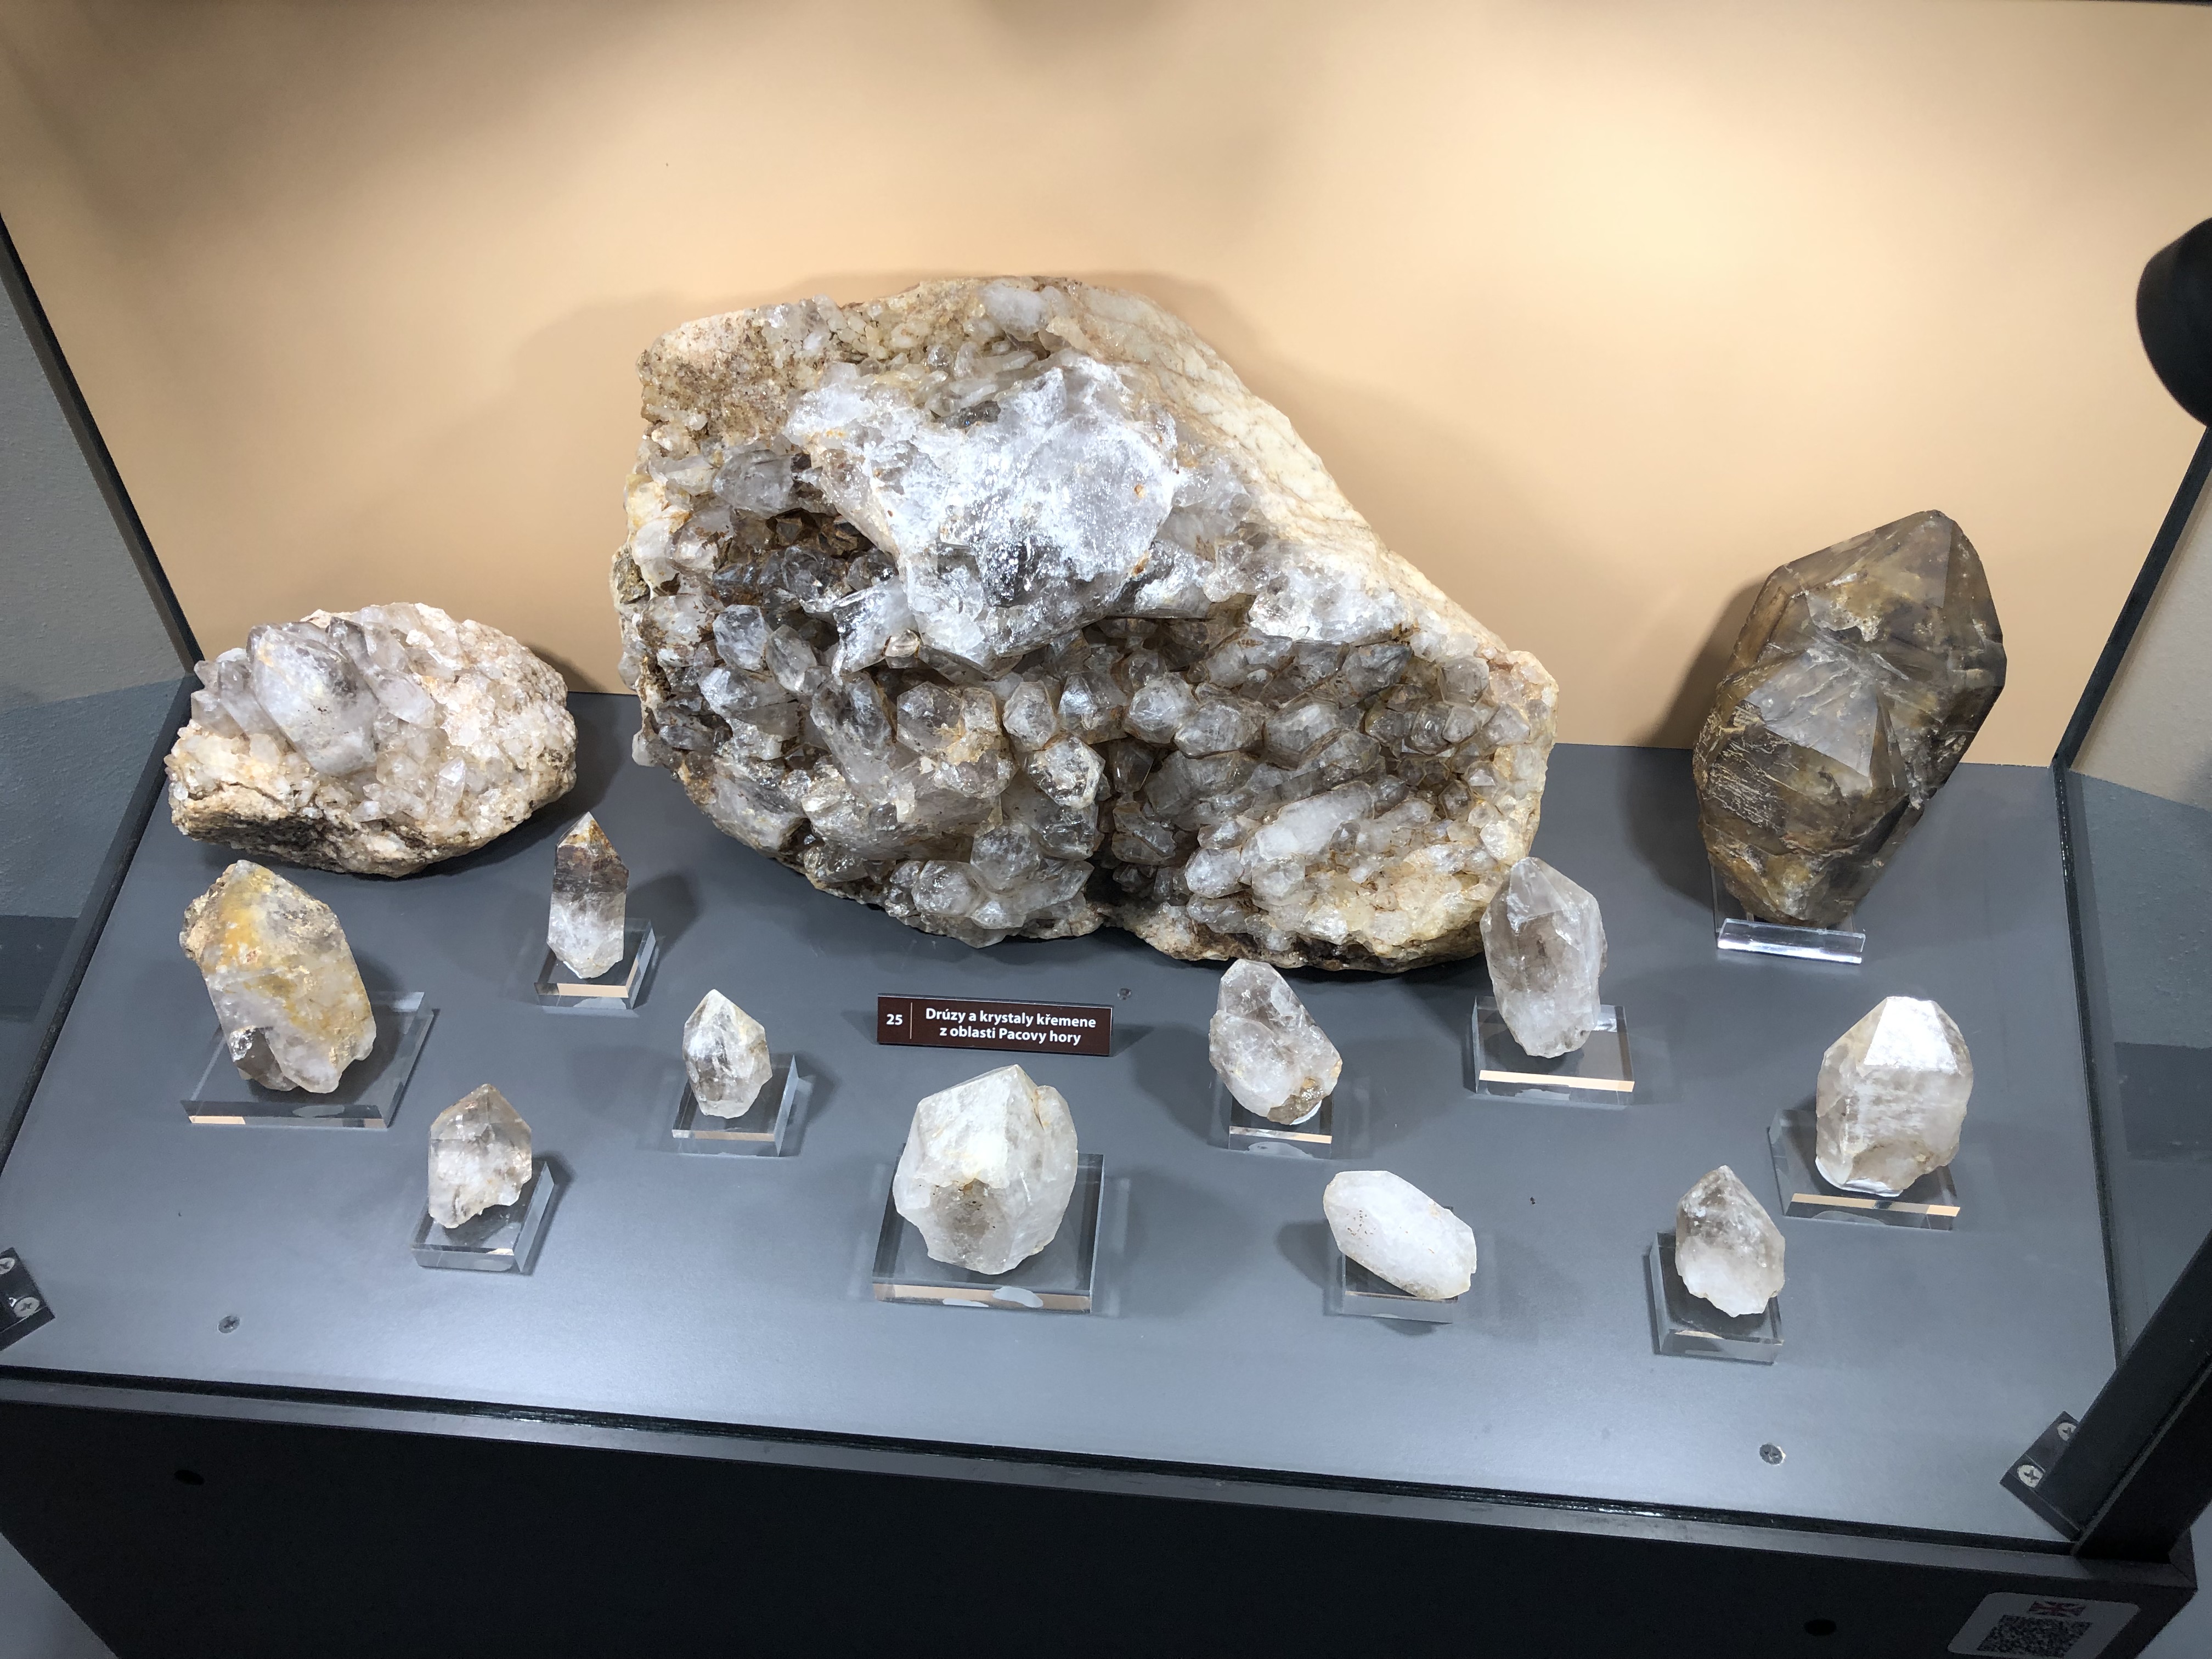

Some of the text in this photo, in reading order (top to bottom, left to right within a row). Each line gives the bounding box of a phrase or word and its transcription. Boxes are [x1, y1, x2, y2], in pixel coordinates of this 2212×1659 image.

[886, 1013, 903, 1025] 25
[926, 1008, 1096, 1028] Drúzy a krystaly křemene
[939, 1025, 1081, 1046] z oblasti Pacovy hory
